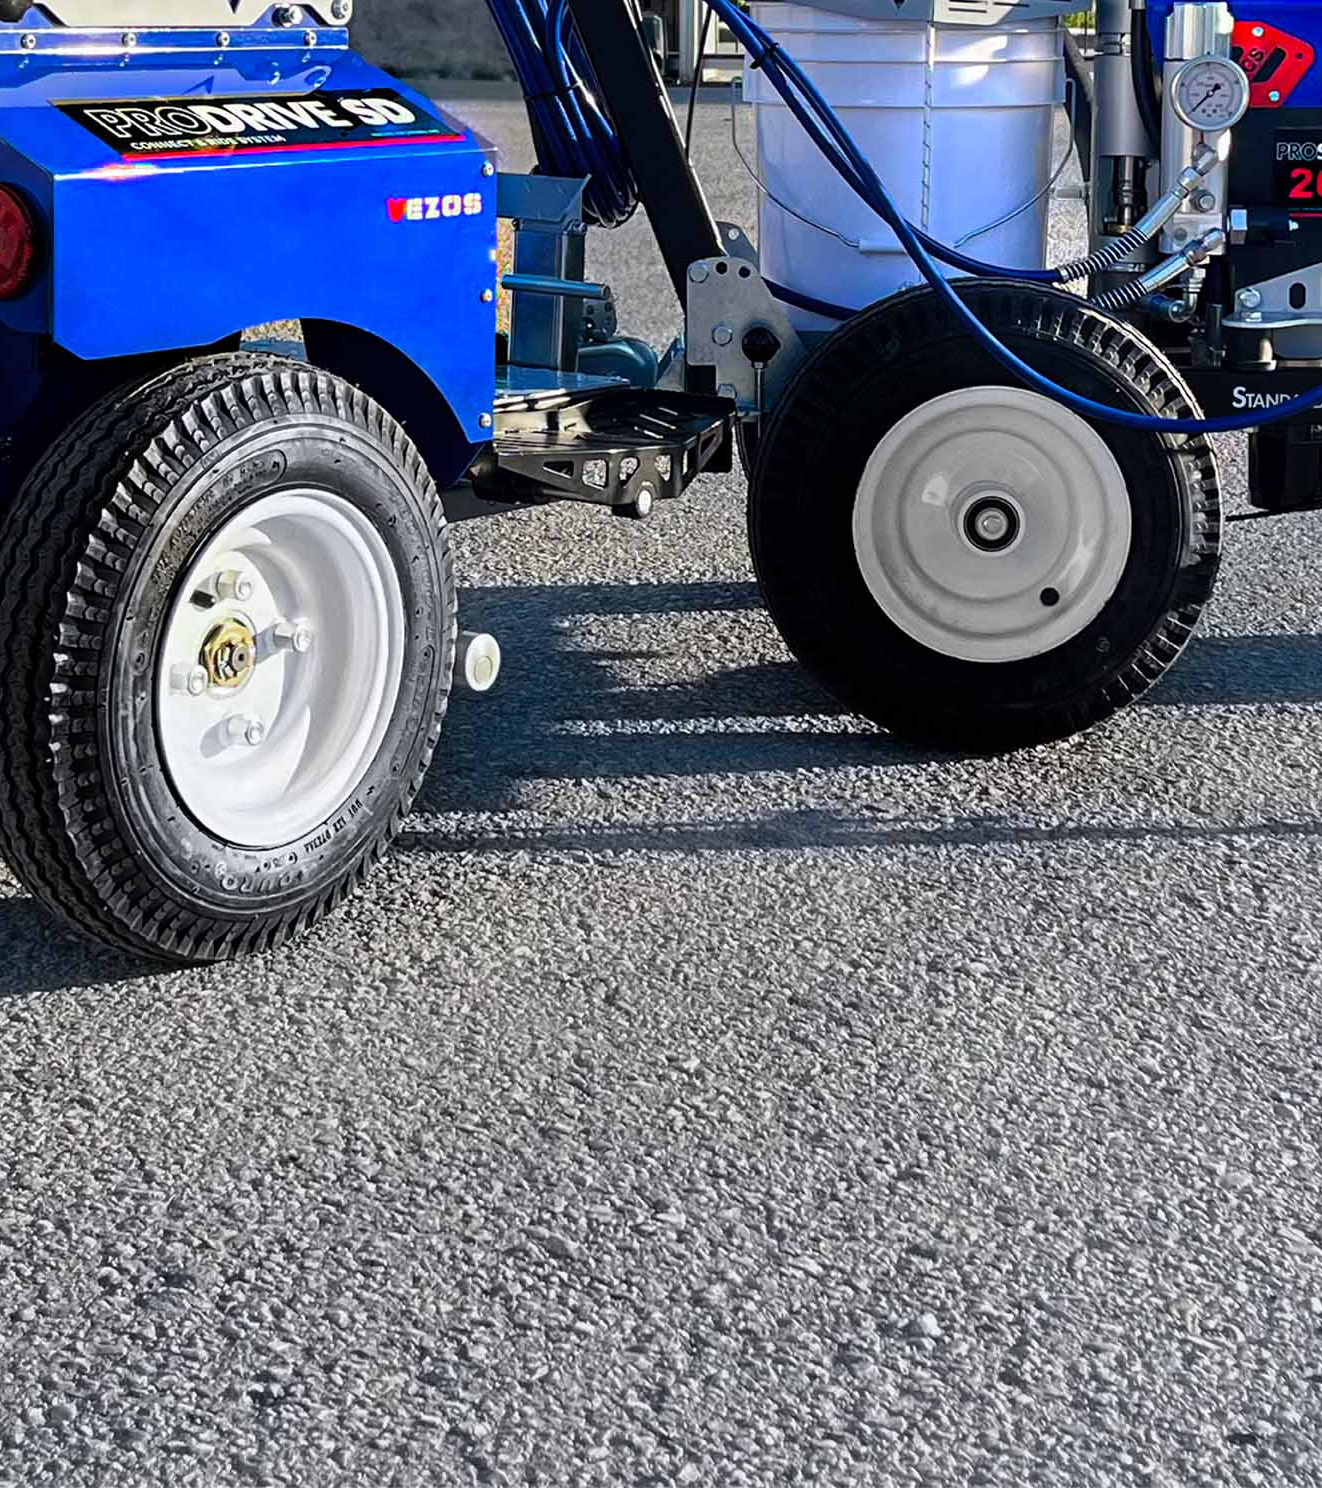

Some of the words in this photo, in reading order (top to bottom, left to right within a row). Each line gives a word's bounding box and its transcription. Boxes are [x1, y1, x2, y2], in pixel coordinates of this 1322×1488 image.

[83, 101, 354, 138] PRODRIVE
[339, 98, 416, 126] SD
[130, 138, 194, 150] CONNECT
[387, 193, 482, 223] VEZOS
